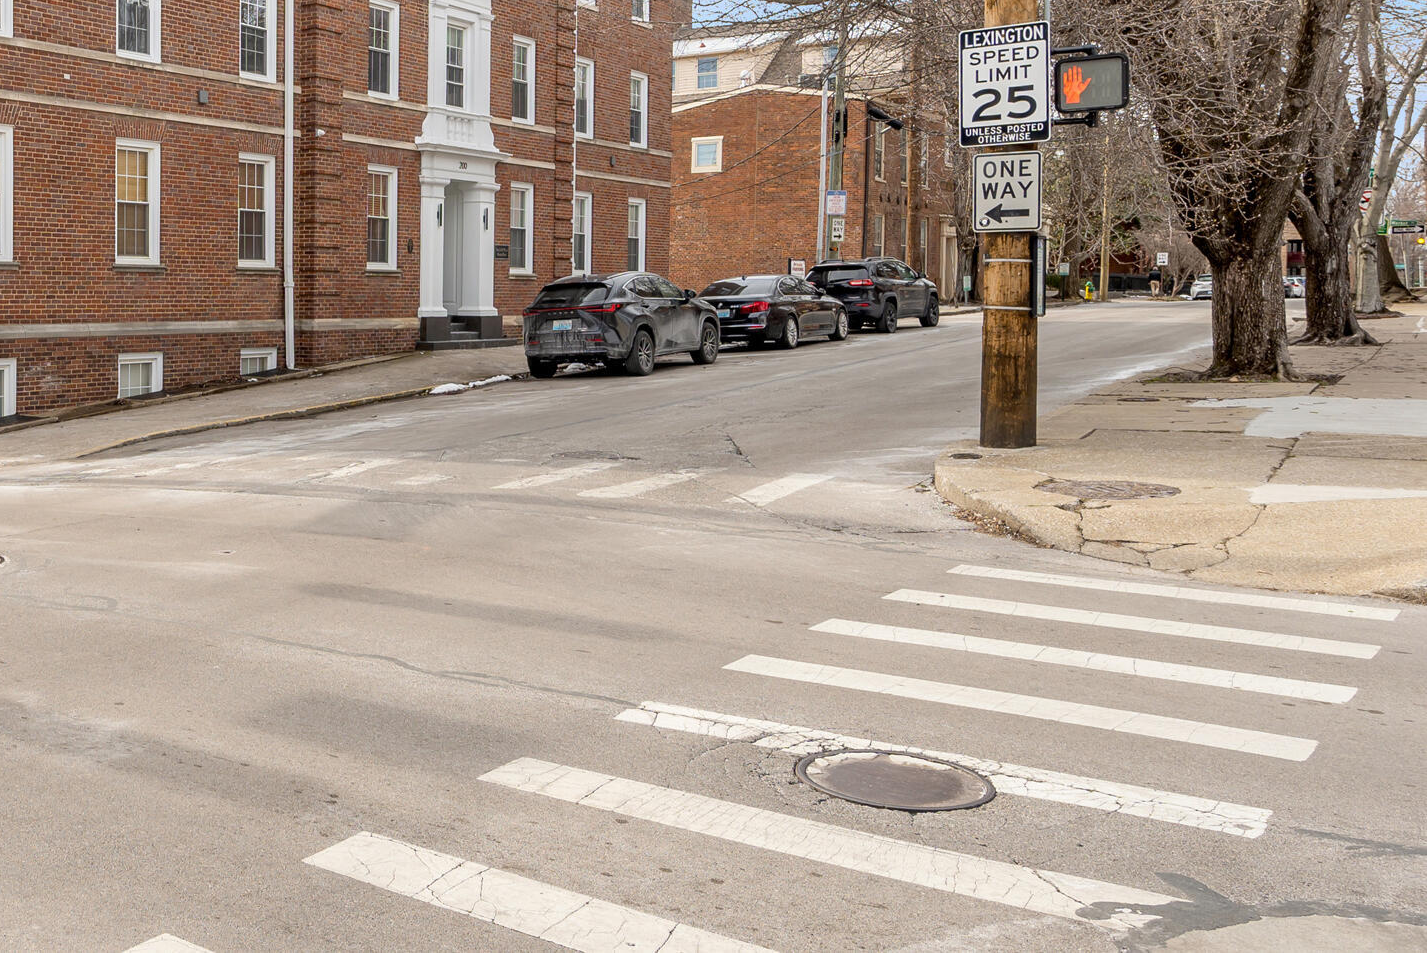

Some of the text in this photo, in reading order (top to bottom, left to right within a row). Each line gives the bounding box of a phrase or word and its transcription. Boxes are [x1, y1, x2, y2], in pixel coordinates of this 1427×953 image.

[965, 25, 1044, 48] LEXINGTON
[969, 45, 1039, 66] SPEED
[976, 64, 1032, 83] LIMIT
[972, 84, 1037, 122] 25
[966, 123, 1044, 137] UNLESS POSTED
[978, 132, 1031, 144] OTHERWISE
[983, 159, 1032, 178] ONE
[982, 181, 1033, 200] WAY
